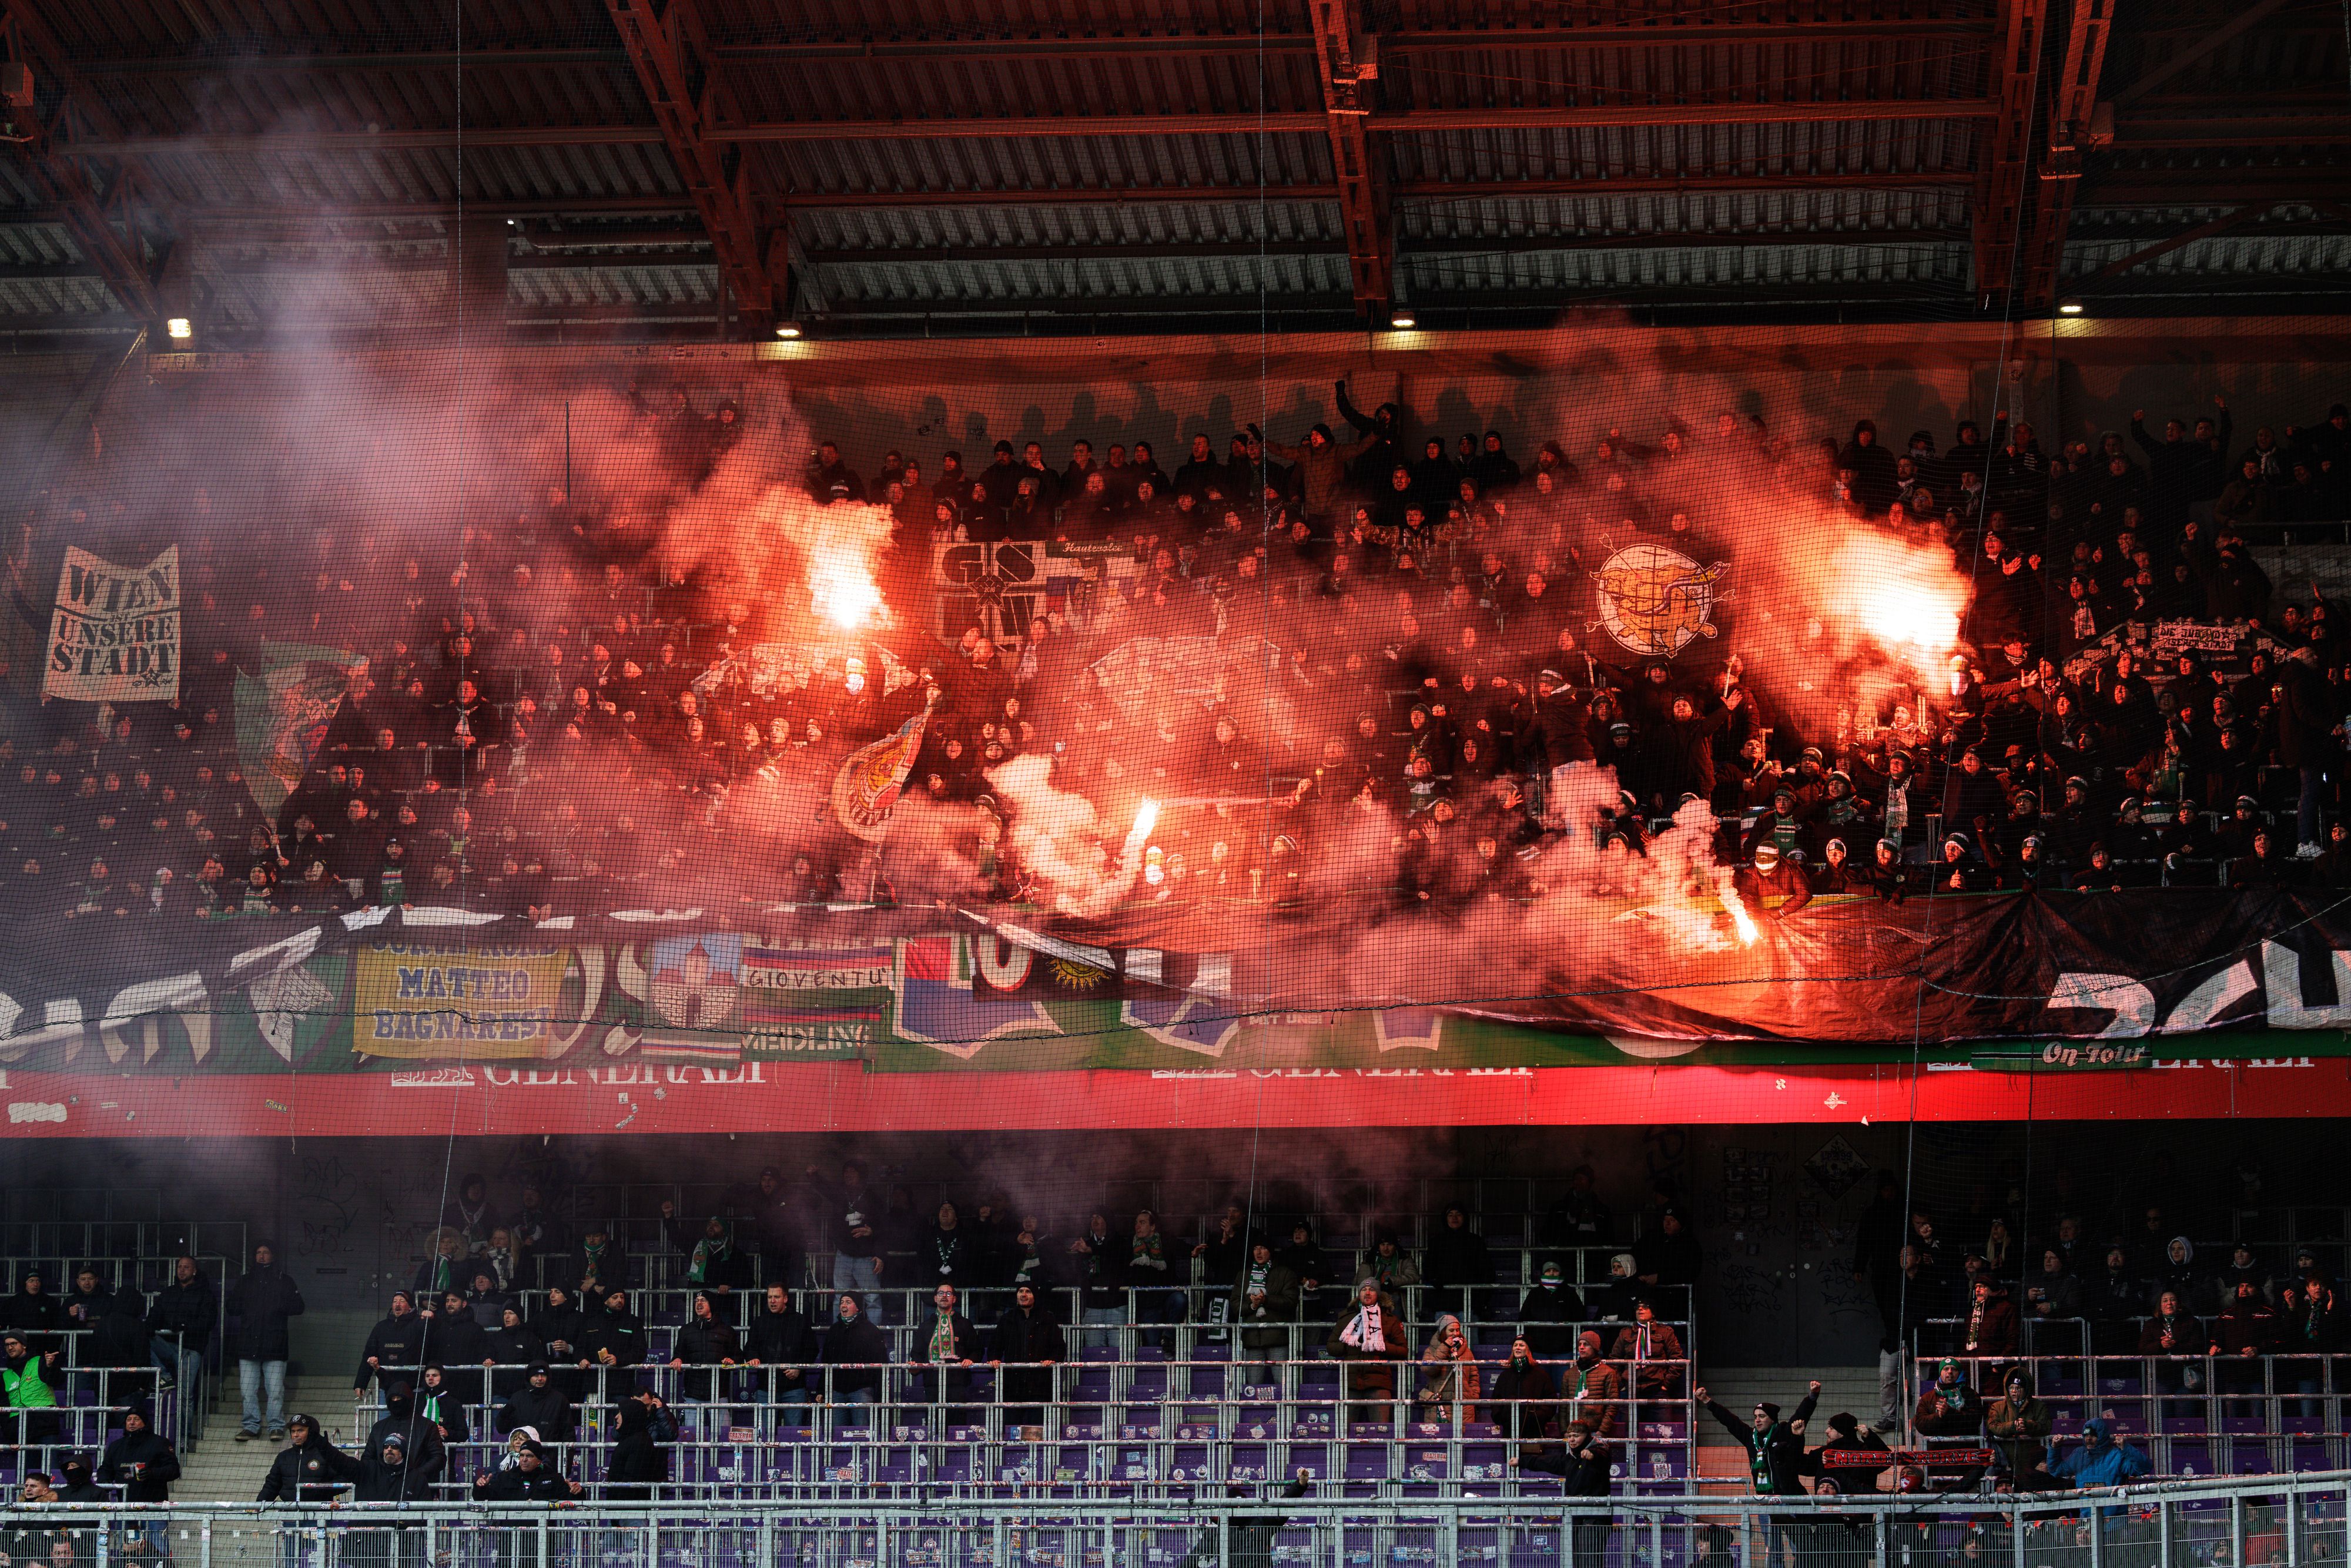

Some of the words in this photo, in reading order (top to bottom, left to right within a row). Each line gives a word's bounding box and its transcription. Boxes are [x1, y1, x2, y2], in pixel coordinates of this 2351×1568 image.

[70, 564, 171, 612] WIEN
[58, 615, 174, 646] UNSERE
[52, 643, 176, 675] STADT
[397, 966, 531, 1001] MATTEO
[373, 1004, 551, 1042] BAGNARESI
[2042, 1041, 2078, 1067] On
[2085, 1041, 2146, 1064] Tour
[729, 1432, 745, 1440] GRAZER
[1834, 1452, 1887, 1465] NORD
[1914, 1448, 1980, 1464] KURVE
